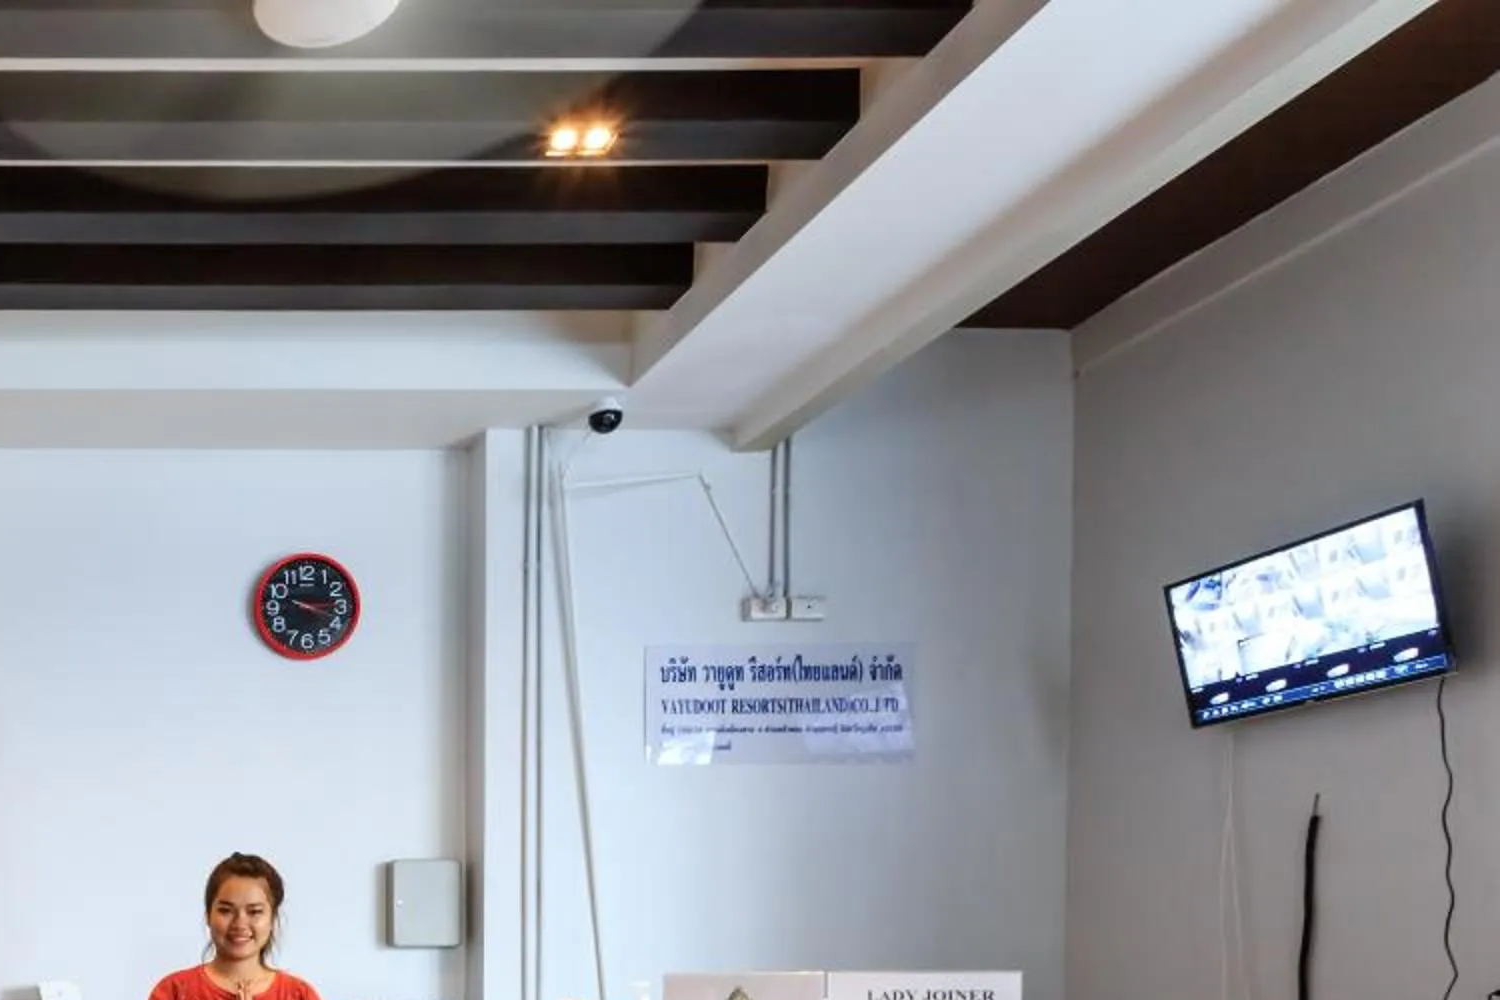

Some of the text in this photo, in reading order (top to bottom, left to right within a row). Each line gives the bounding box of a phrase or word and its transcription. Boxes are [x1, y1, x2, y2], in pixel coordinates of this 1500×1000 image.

[284, 570, 296, 584] 11
[299, 565, 315, 580] 12
[271, 583, 289, 599] 10
[329, 581, 343, 597] 2
[265, 600, 280, 616] 9
[334, 598, 347, 615] 3
[271, 616, 286, 632] 8
[329, 616, 342, 630] 4
[286, 628, 299, 646] 7
[300, 633, 315, 649] 6
[317, 628, 331, 645] 5
[661, 699, 726, 714] VAYUDOOT
